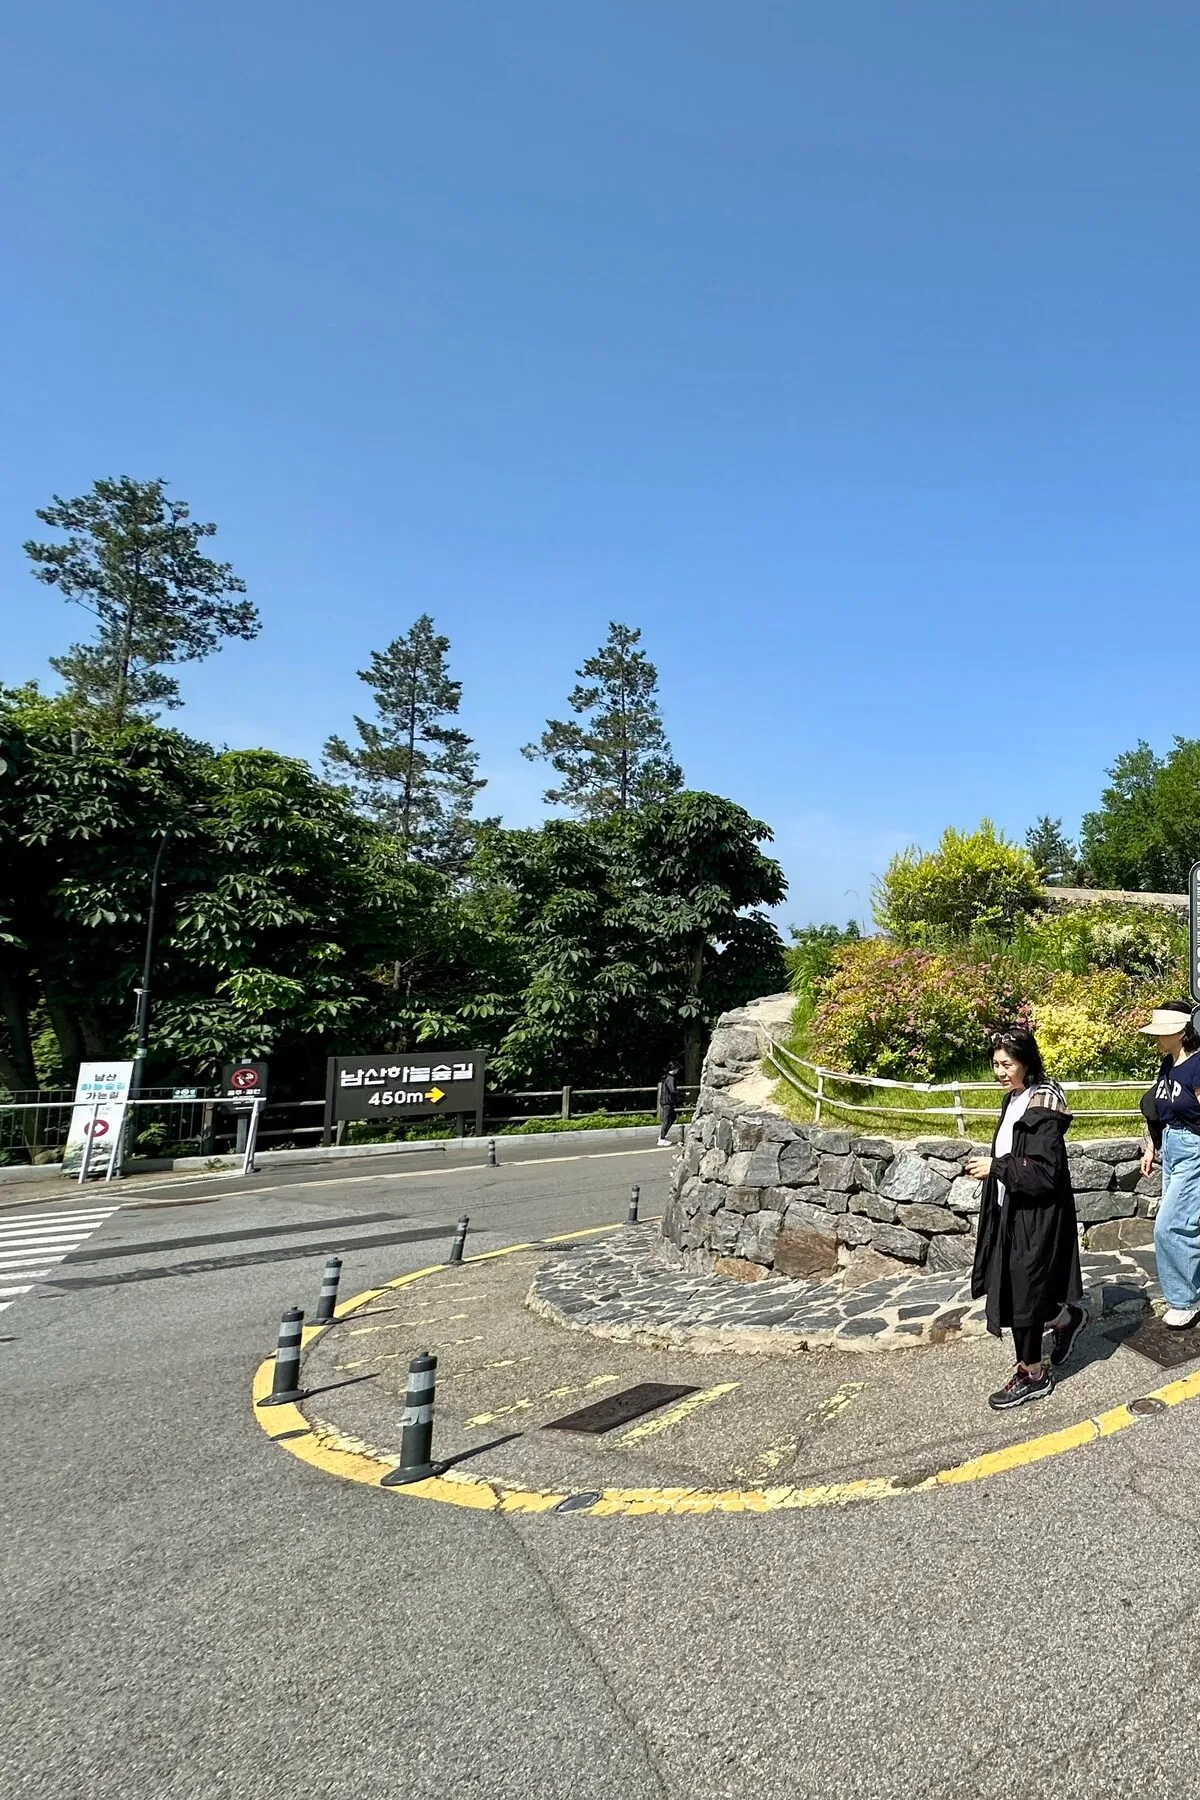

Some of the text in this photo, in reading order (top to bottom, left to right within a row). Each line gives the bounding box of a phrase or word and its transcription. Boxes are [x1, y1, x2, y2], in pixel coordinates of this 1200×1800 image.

[95, 1073, 117, 1082] 남산
[340, 1062, 474, 1087] 남산하늘숲길
[80, 1082, 126, 1091] 하늘숲길
[1155, 1079, 1182, 1103] GP
[85, 1091, 119, 1100] 가는길
[368, 1090, 424, 1106] 450m
